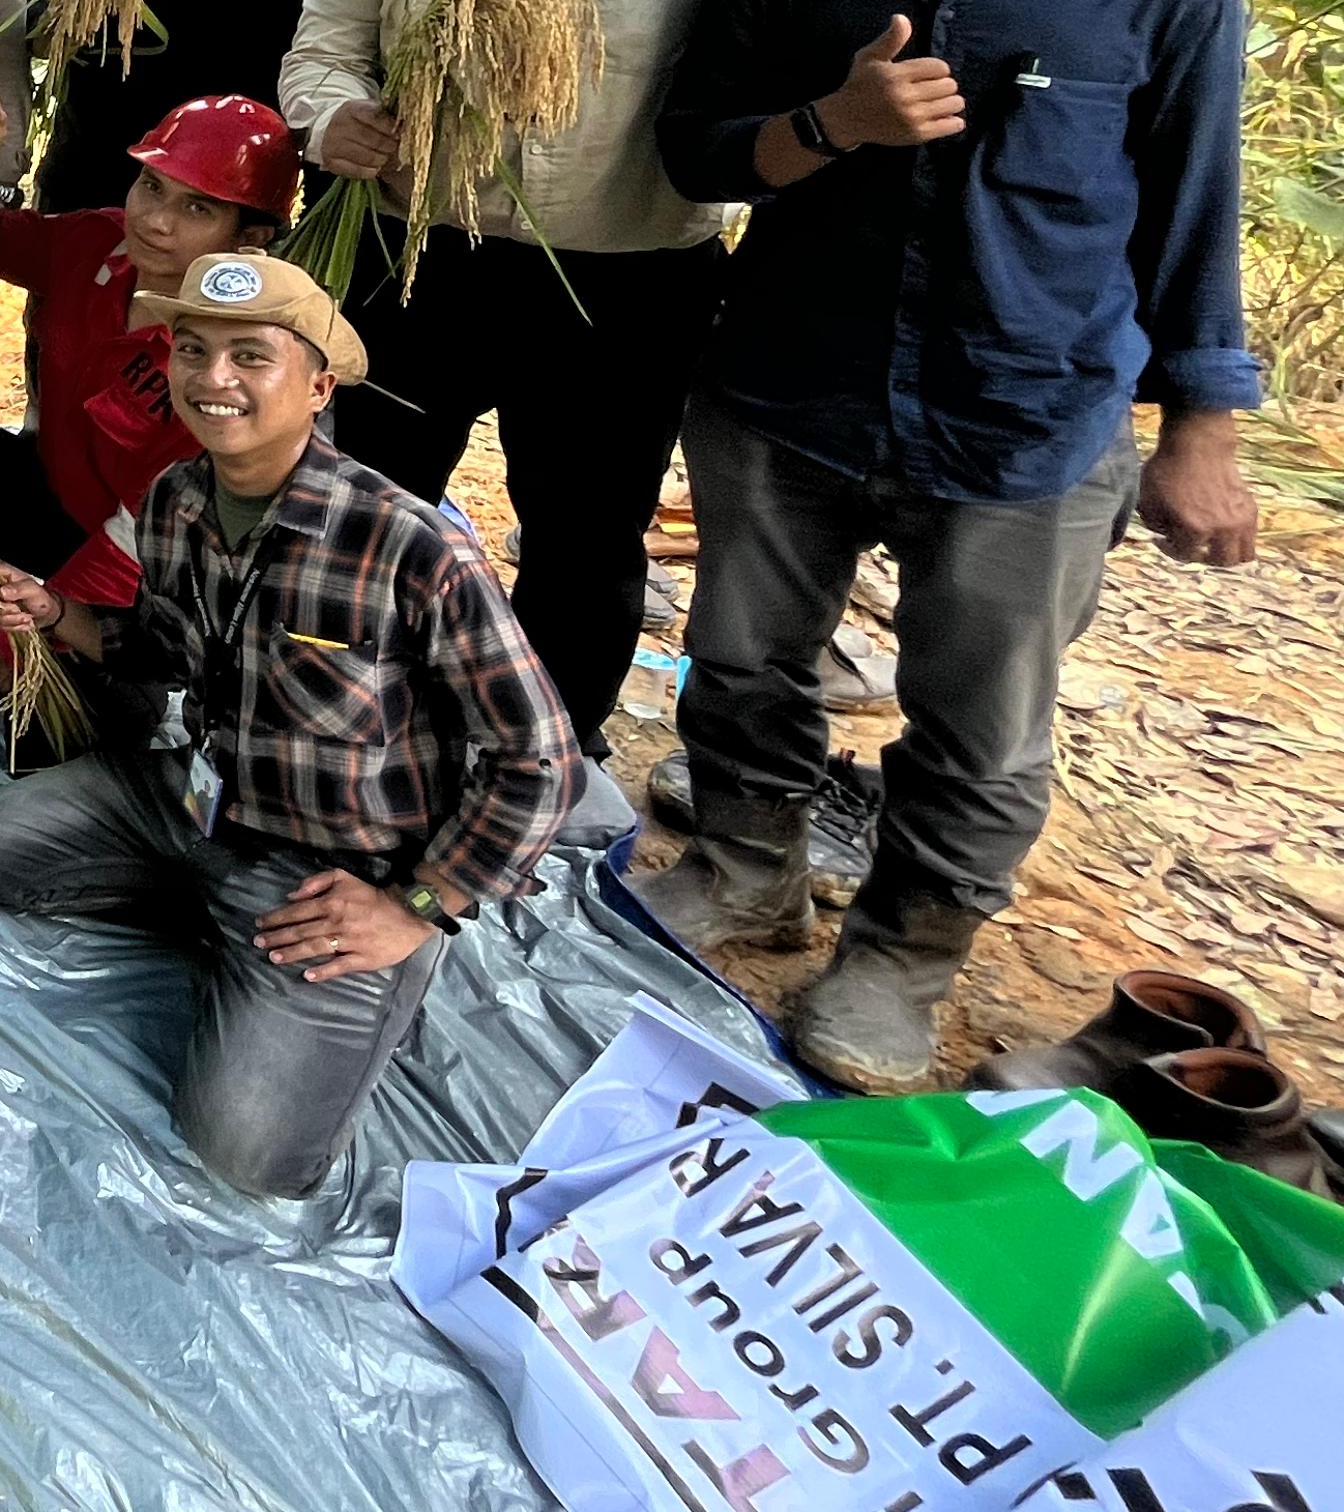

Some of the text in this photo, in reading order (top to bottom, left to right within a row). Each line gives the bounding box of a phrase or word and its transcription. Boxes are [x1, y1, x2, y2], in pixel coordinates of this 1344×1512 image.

[120, 350, 173, 425] RPK
[538, 1232, 792, 1512] TAR
[648, 1237, 871, 1474] Group
[669, 1137, 1034, 1486] PT. SILVA R
